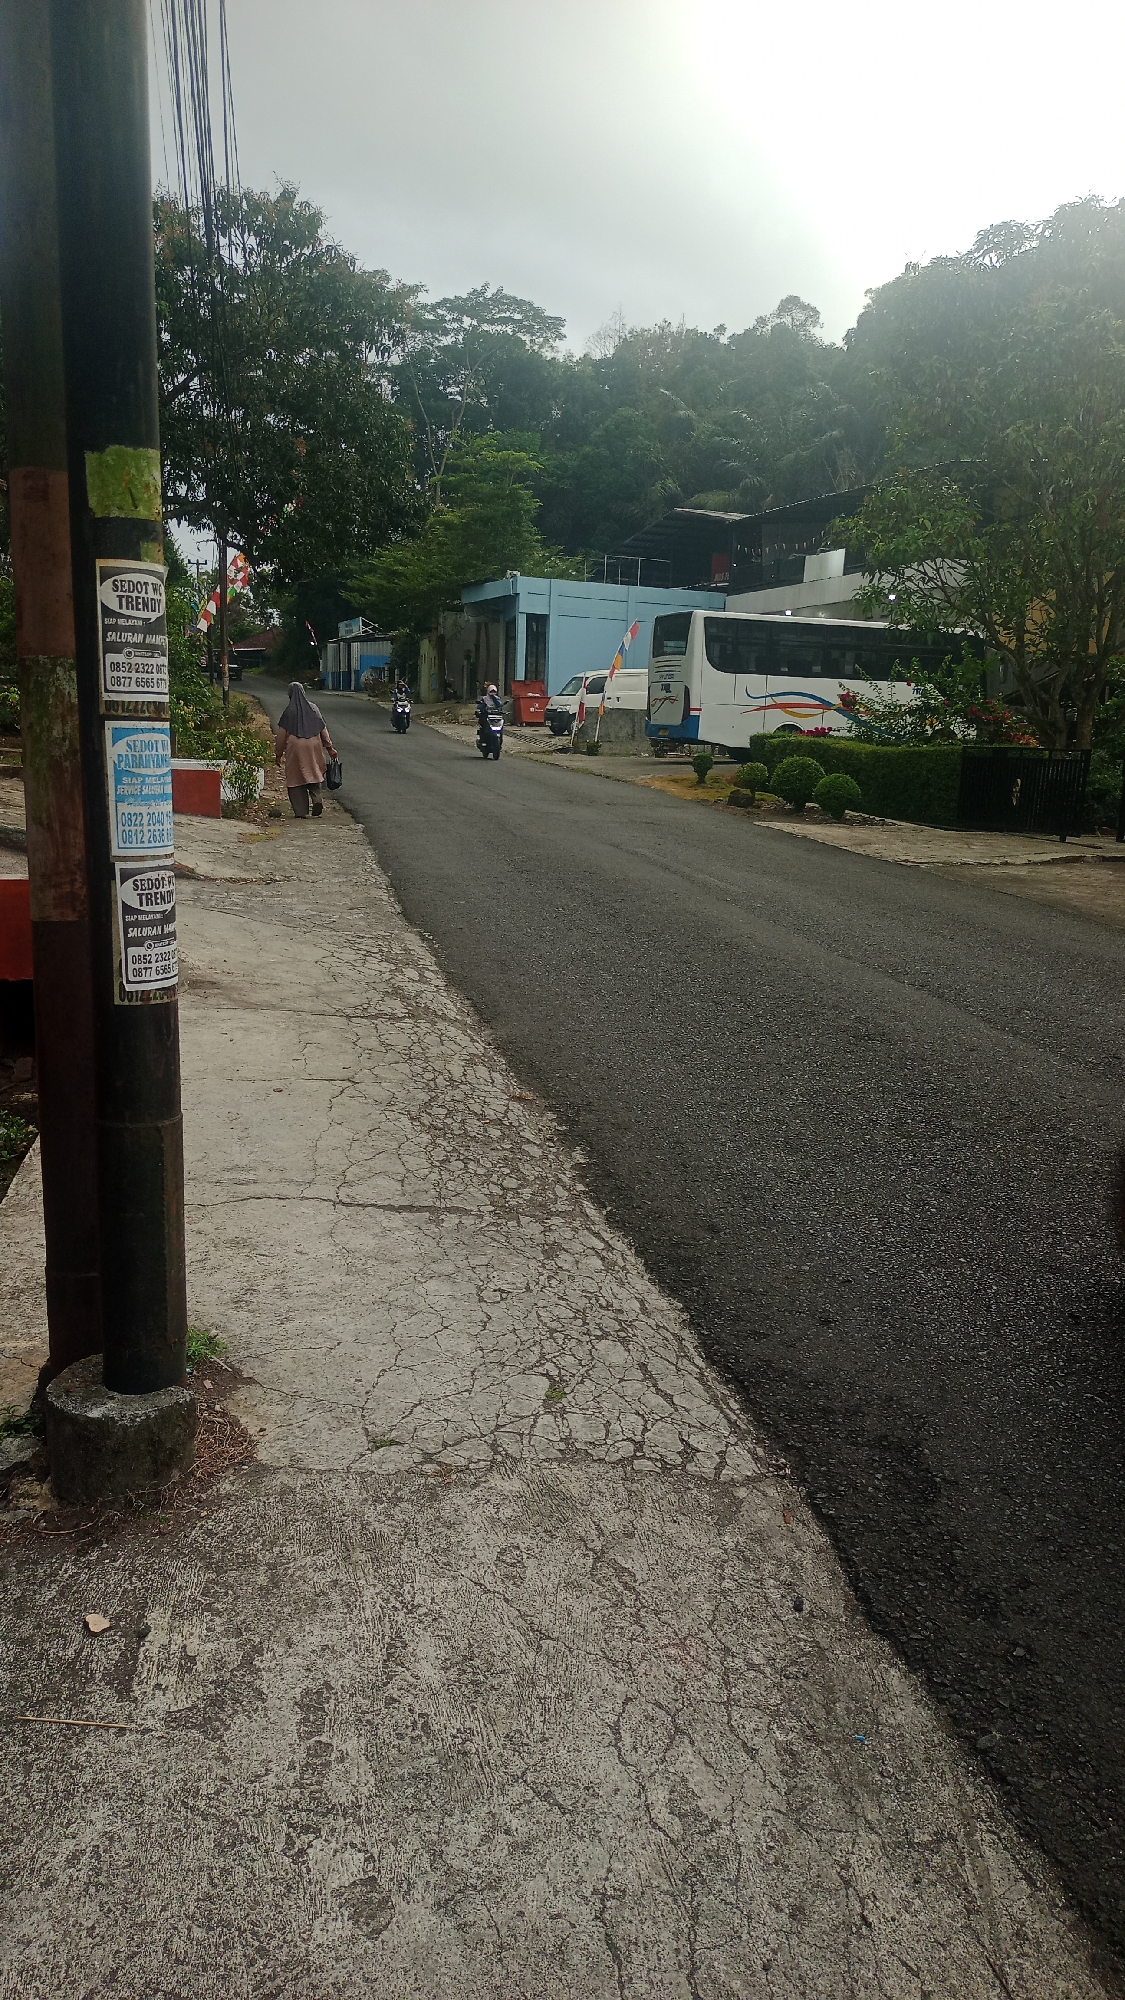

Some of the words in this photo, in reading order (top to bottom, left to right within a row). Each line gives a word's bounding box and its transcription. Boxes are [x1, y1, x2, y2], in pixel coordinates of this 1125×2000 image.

[112, 579, 149, 595] SEDOT
[151, 582, 163, 597] WC
[116, 595, 161, 613] TRENDY
[106, 631, 144, 644] SALURAN
[110, 662, 132, 673] 0852
[135, 662, 154, 674] 2322
[110, 676, 132, 687] 0877
[135, 677, 155, 688] 6565
[126, 739, 158, 752] SEDOT
[122, 776, 143, 784] SIAP
[121, 811, 144, 827] 0822
[147, 811, 165, 827] 2040
[121, 829, 145, 844] 0812
[147, 828, 166, 844] 2636
[132, 877, 165, 892] SEDOT
[137, 889, 175, 907] TRENDY
[127, 925, 162, 938] SALURAN
[132, 954, 153, 965] 0852
[154, 951, 171, 963] 2322
[132, 967, 153, 978] 0877
[155, 963, 171, 976] 6565
